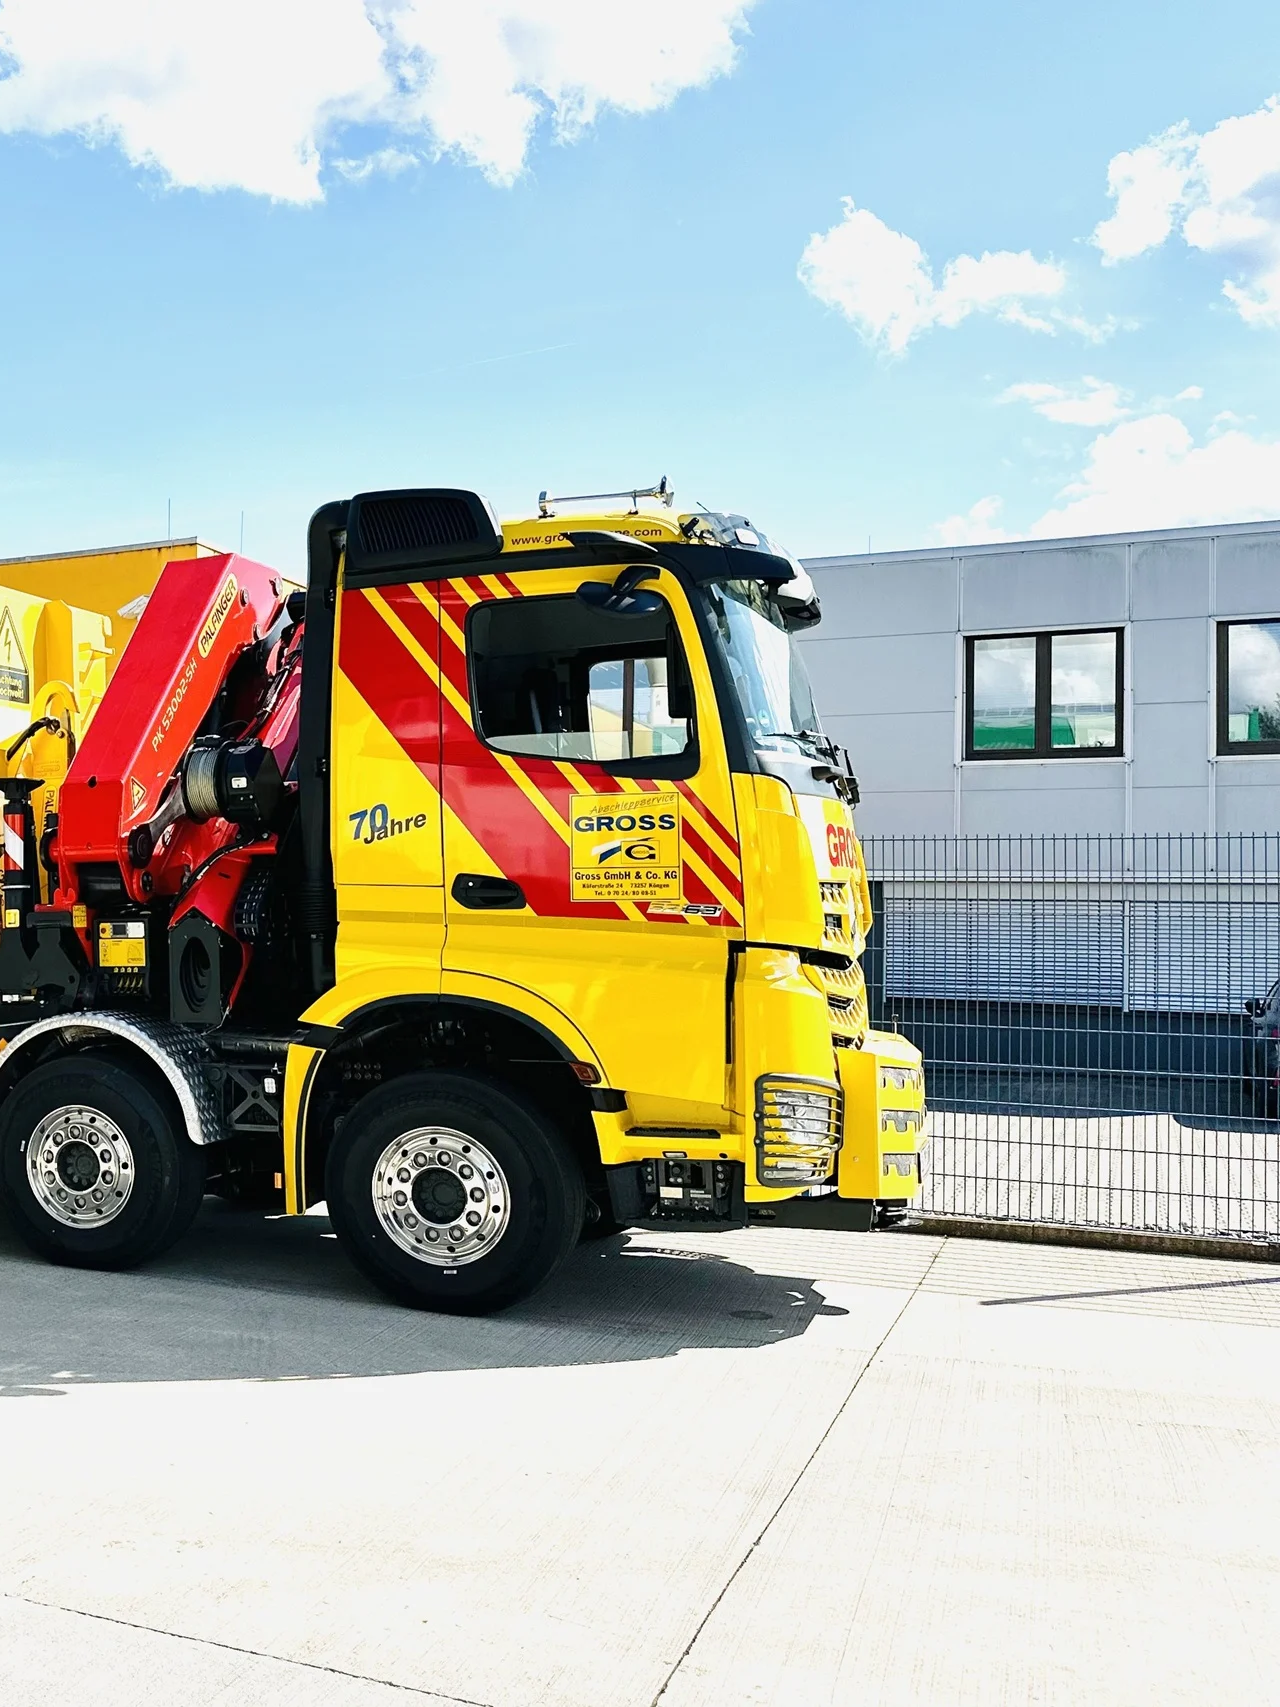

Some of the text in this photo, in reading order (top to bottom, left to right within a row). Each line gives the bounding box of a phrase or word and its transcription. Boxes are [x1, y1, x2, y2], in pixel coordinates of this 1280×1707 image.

[200, 578, 237, 653] PALFINGER
[151, 657, 198, 752] PK 53002-SH
[590, 794, 675, 815] Abschleppservice
[349, 803, 426, 844] 70 Jahre
[574, 814, 676, 832] GROSS
[574, 870, 678, 880] Gross GmbH & Co. KG
